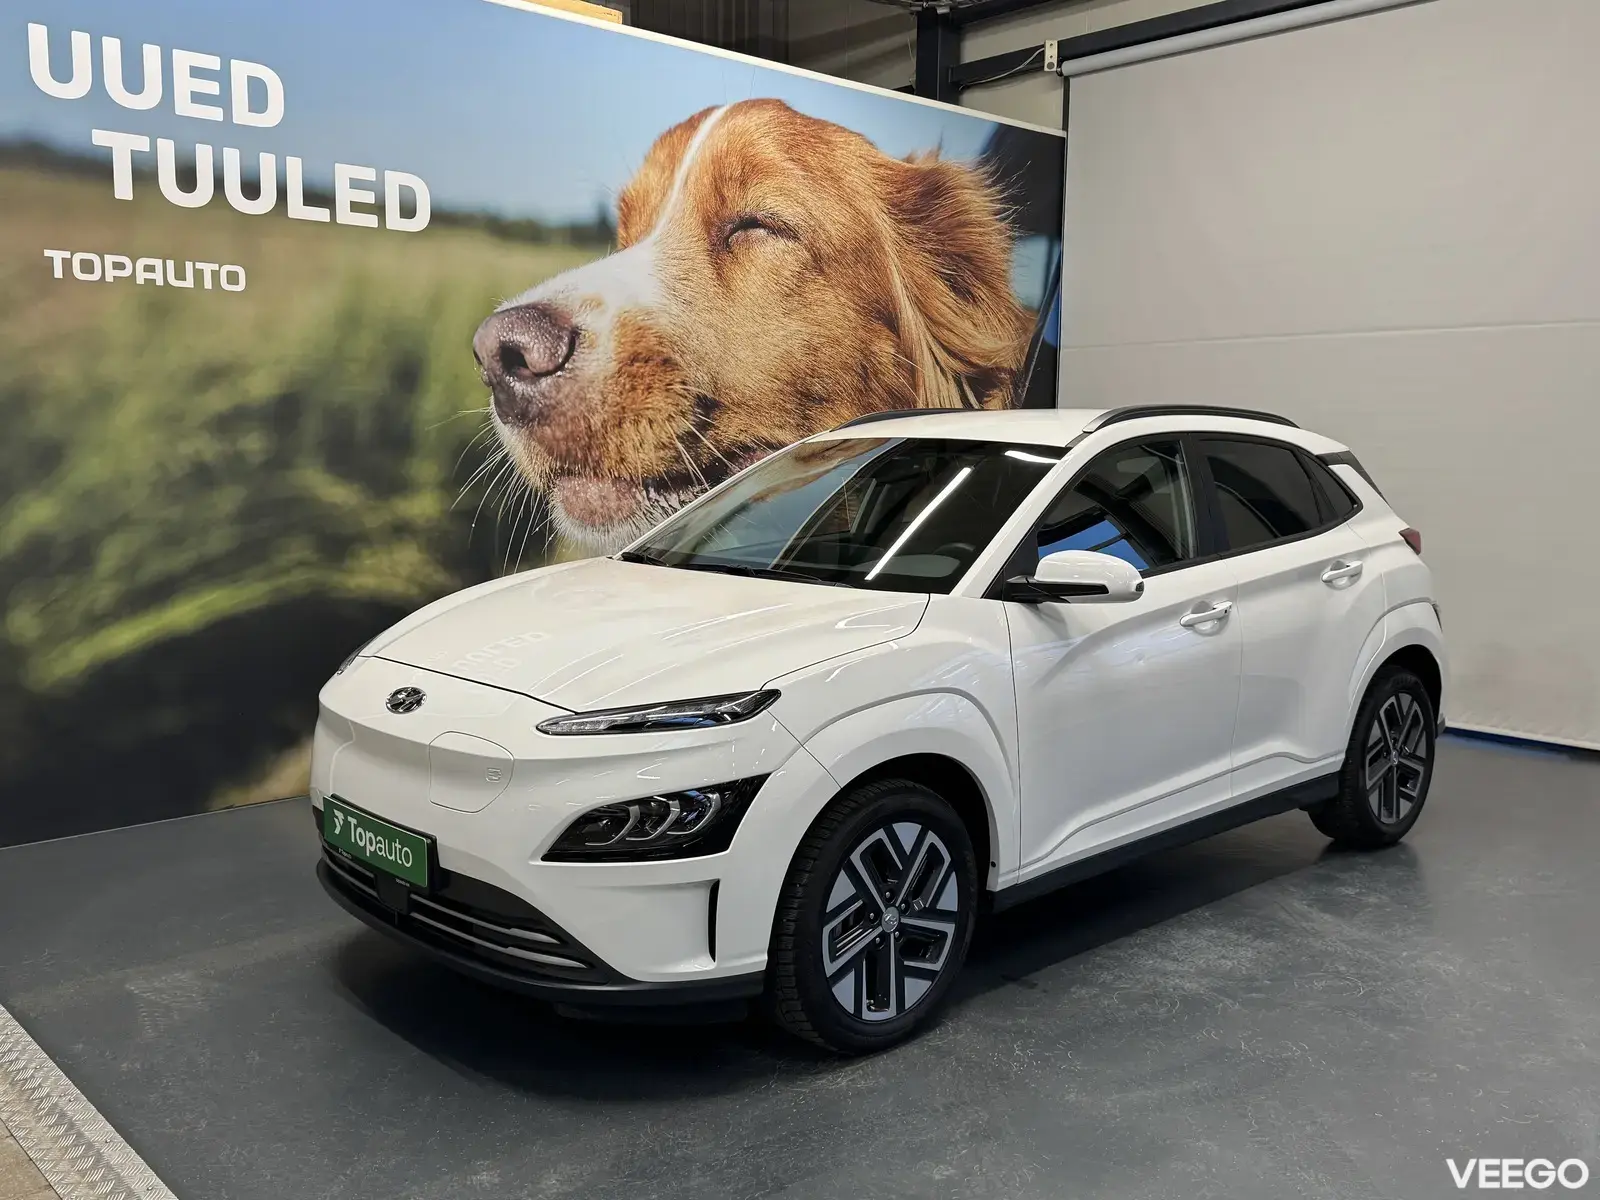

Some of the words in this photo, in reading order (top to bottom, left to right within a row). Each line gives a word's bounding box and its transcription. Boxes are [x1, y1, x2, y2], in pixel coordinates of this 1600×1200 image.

[28, 23, 285, 128] UUED
[92, 129, 431, 232] TUULED
[44, 249, 246, 291] TOPAUTO
[348, 816, 412, 868] Topauto
